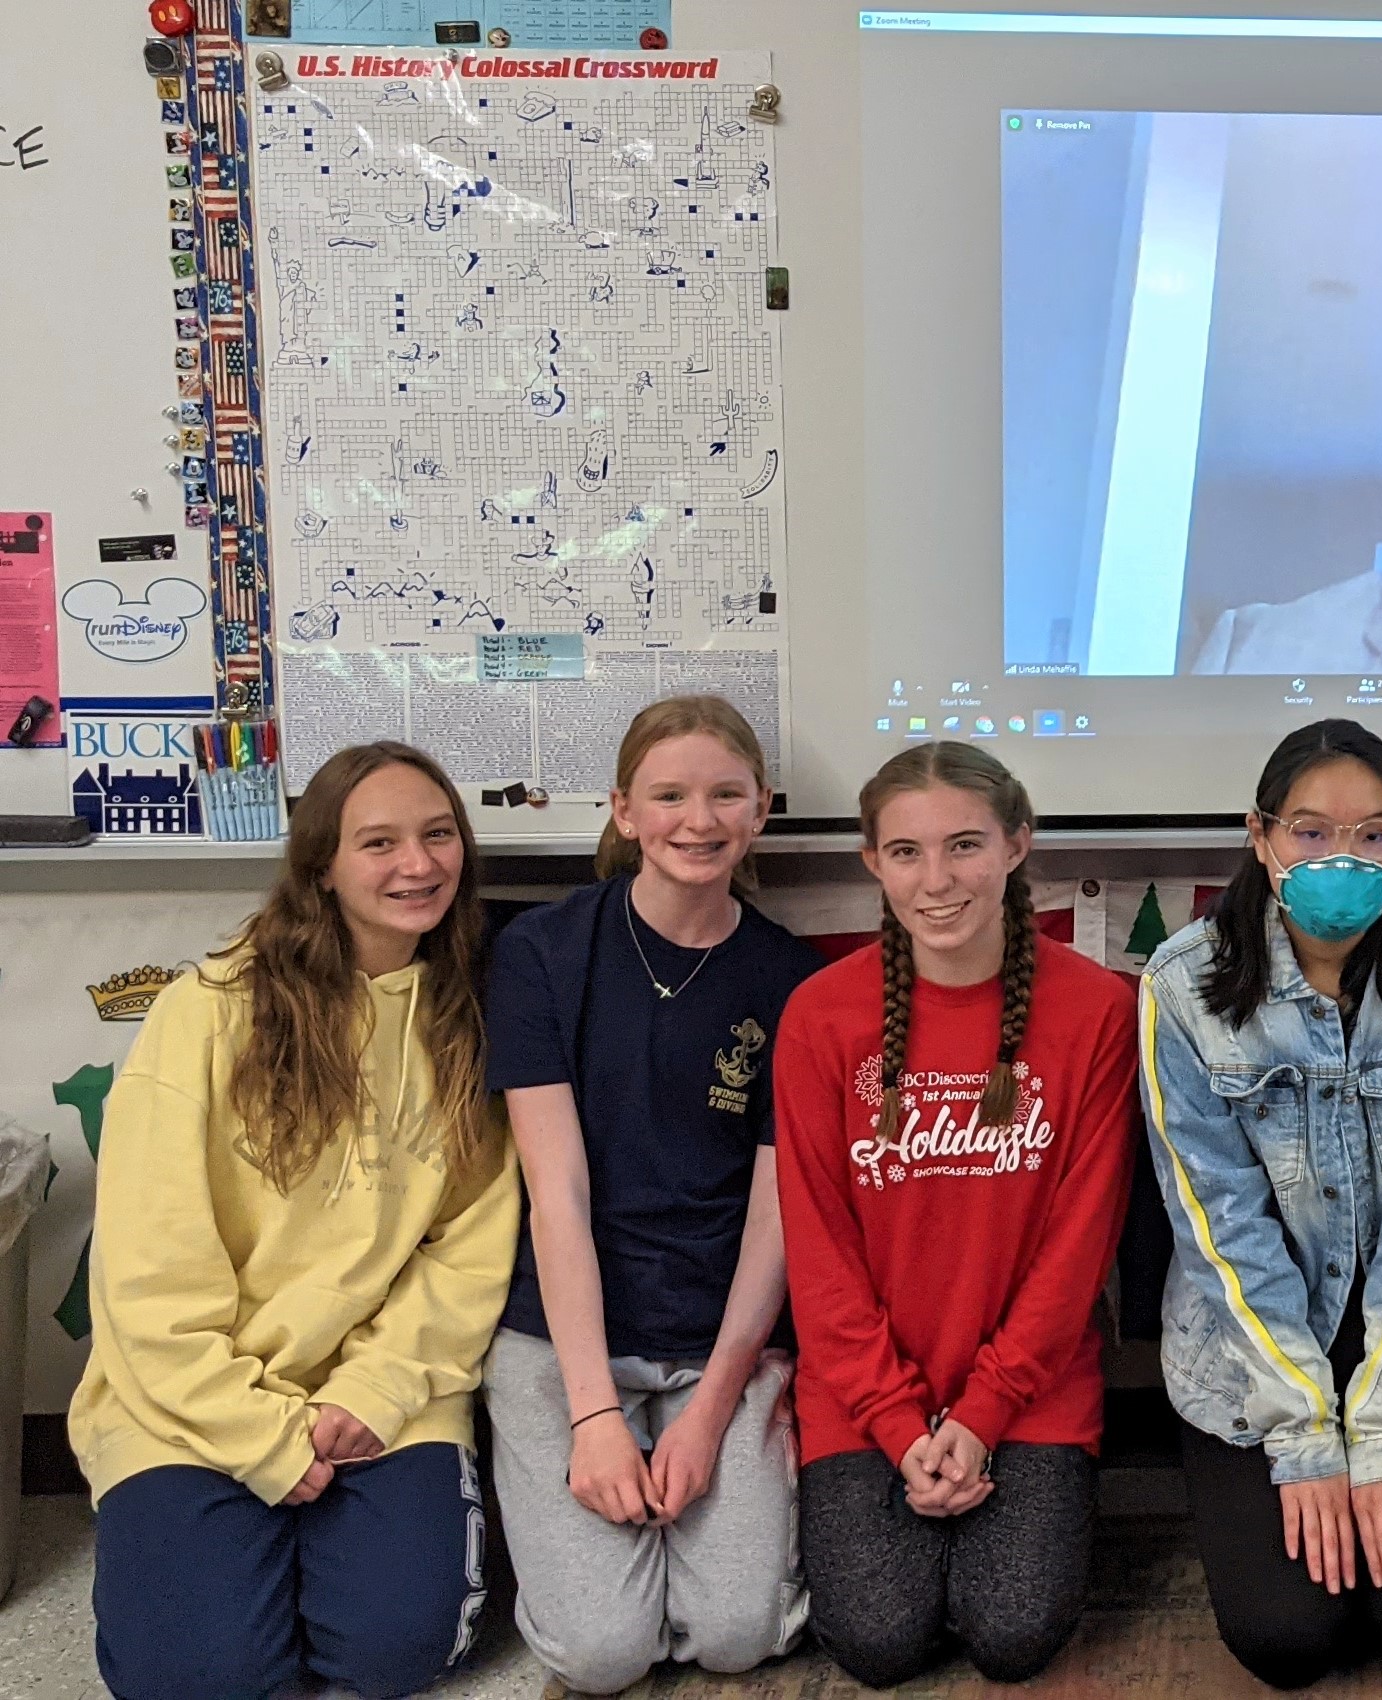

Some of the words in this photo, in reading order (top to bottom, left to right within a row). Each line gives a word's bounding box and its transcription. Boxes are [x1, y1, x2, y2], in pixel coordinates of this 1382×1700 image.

[297, 55, 346, 77] U.S.
[461, 56, 570, 79] Colossal
[573, 57, 719, 80] Crossword
[71, 722, 197, 758] BUCK
[927, 1070, 989, 1086] Discoveri
[923, 1089, 938, 1102] 1st
[940, 1088, 985, 1101] Annual
[851, 1097, 1055, 1174] Holidazzle
[913, 1167, 967, 1178] SHOWCASE
[969, 1165, 993, 1177] 2020
